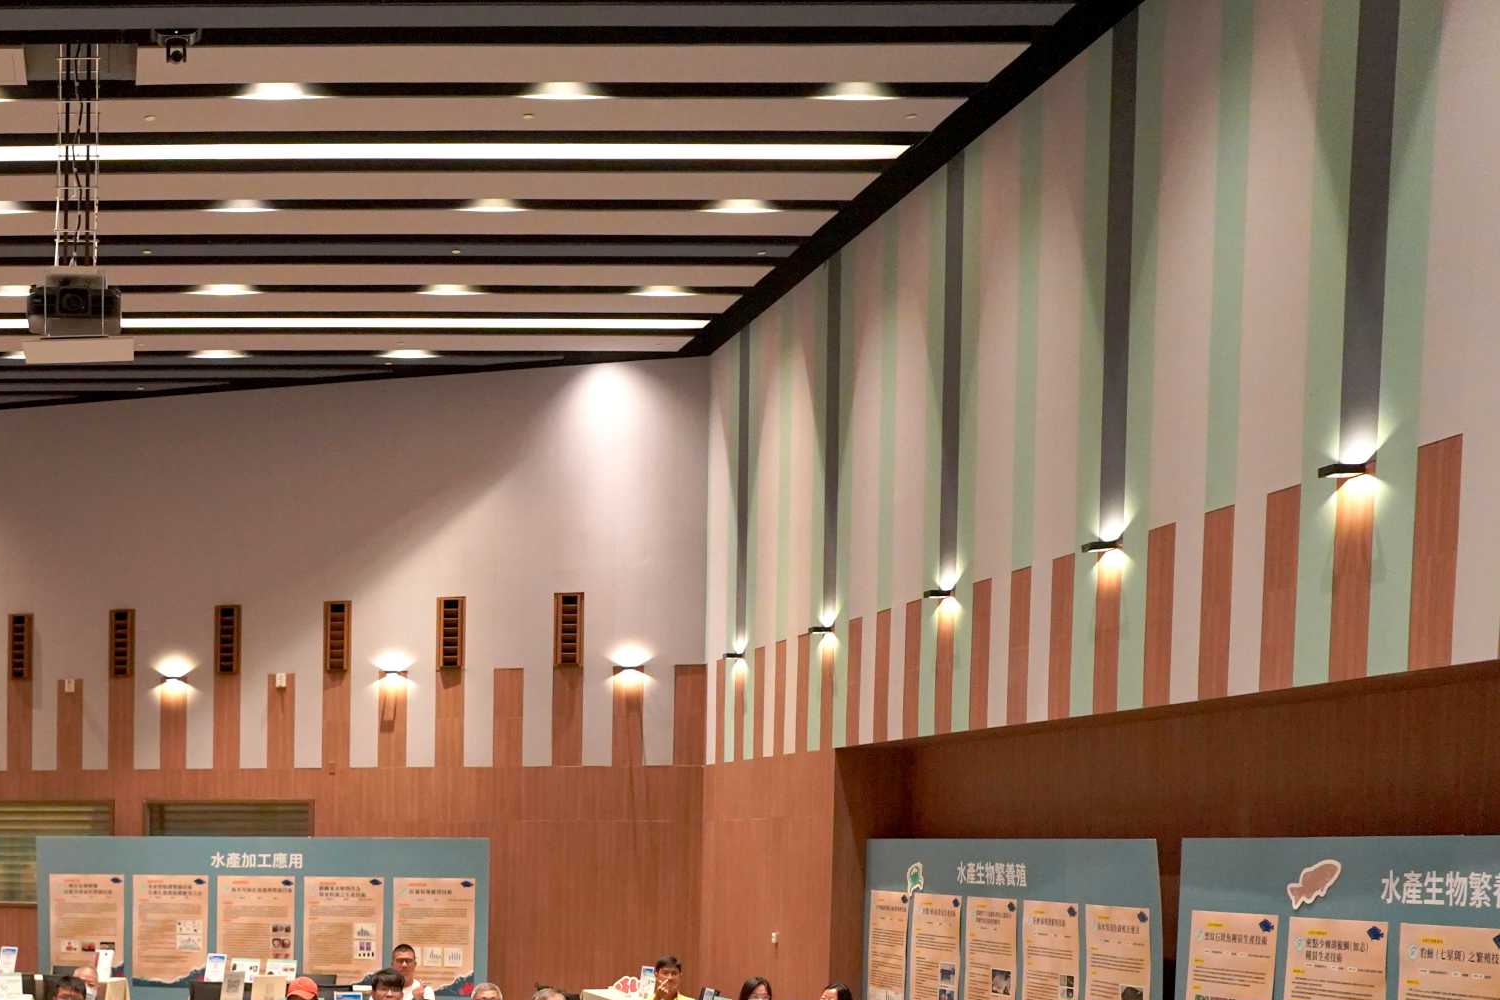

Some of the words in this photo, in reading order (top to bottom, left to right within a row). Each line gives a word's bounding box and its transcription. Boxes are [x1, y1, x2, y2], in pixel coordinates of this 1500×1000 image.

[210, 852, 303, 869] 水產加工應用
[956, 862, 1028, 887] 水產生物繁養殖
